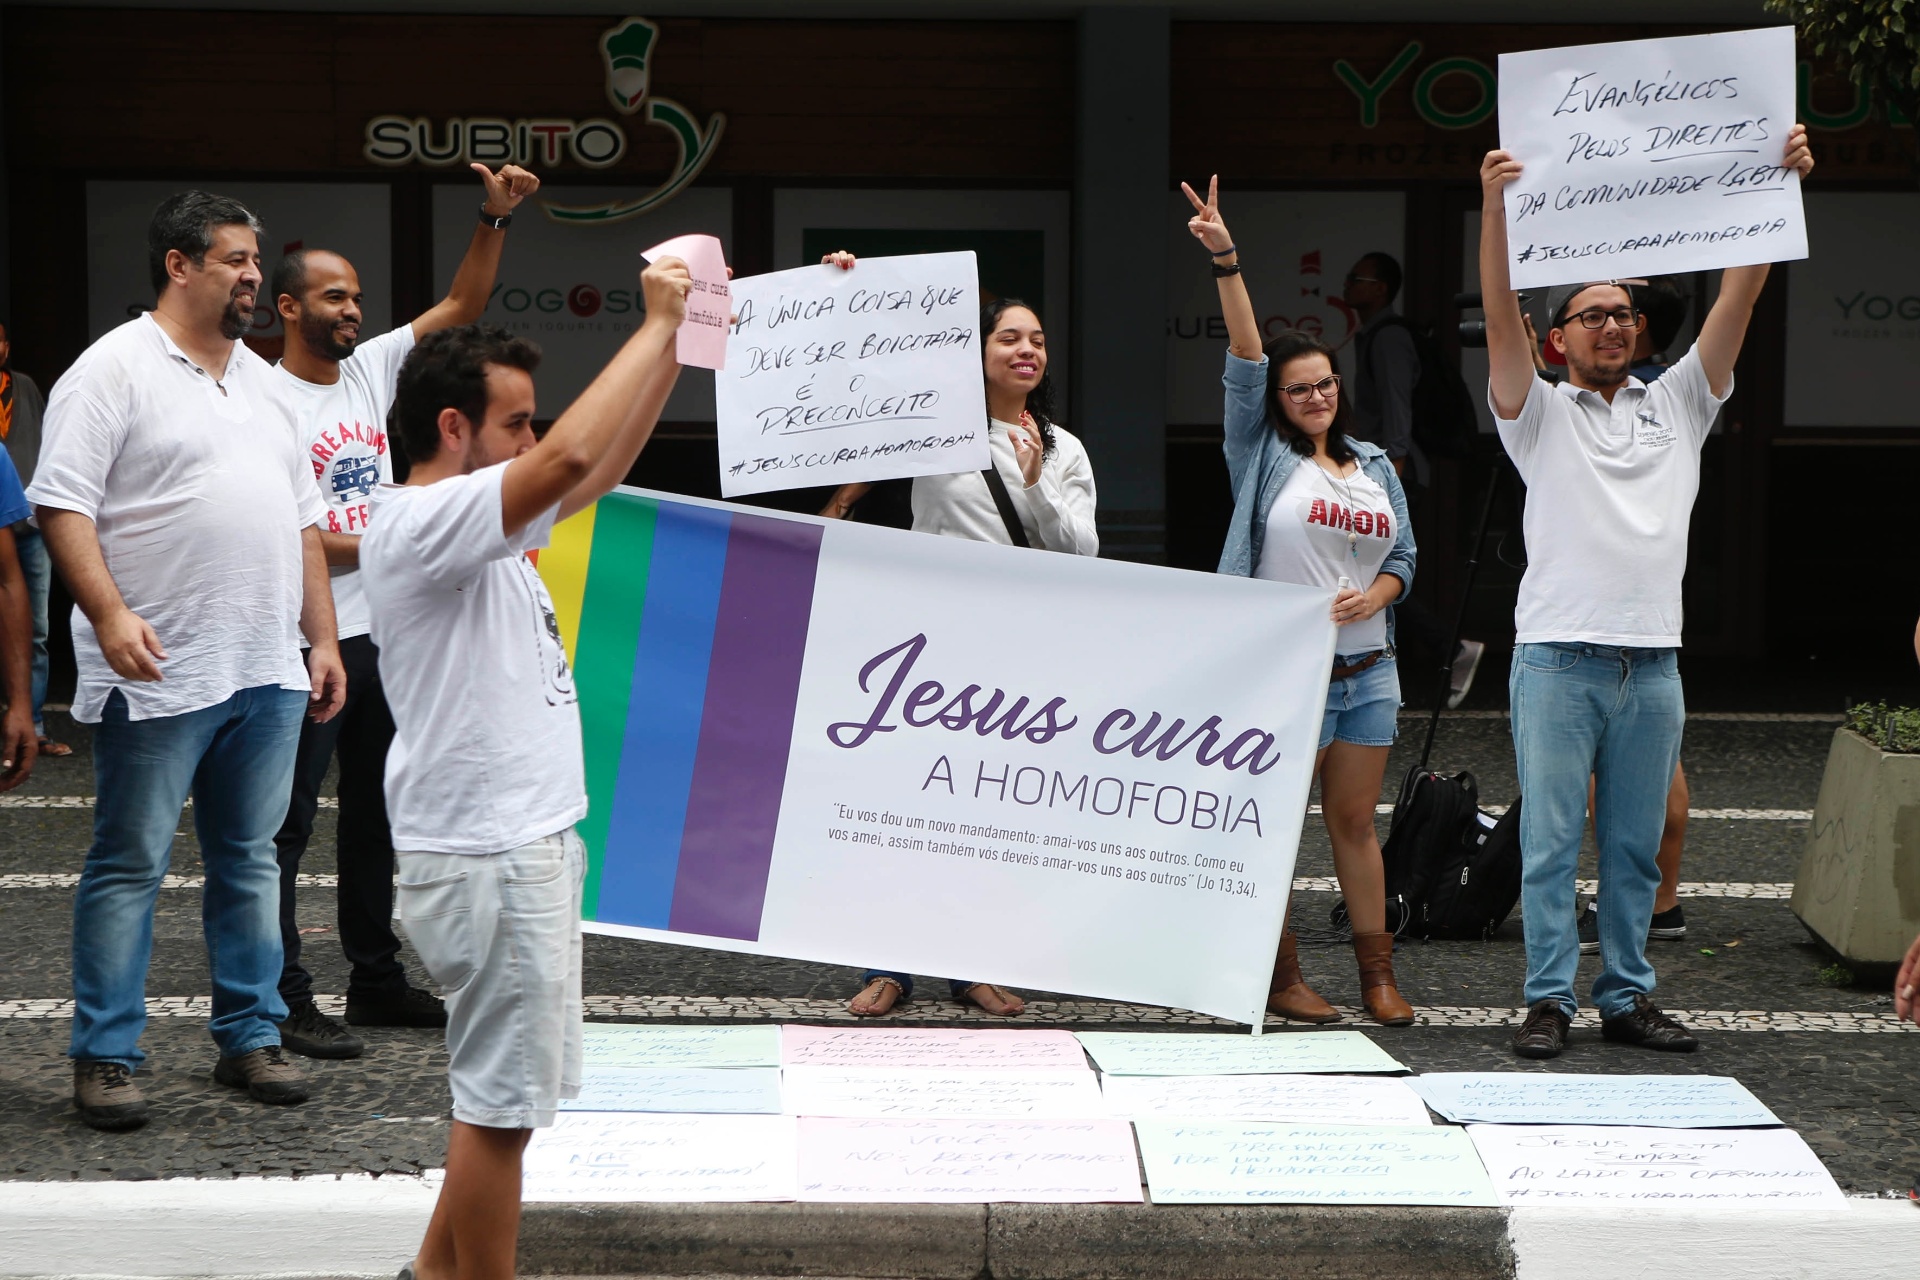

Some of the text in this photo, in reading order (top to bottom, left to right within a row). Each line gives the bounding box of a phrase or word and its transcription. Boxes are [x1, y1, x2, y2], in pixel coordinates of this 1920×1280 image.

[1553, 70, 1739, 117] EVANGÉLICOS
[367, 118, 625, 165] SUBITO
[1566, 117, 1769, 164] PELOS DIREITOS
[1516, 192, 1546, 223] DA
[1555, 174, 1715, 211] COMUNIDADE
[1517, 217, 1787, 264] #JESUSCURAAHOMOFOBIA
[711, 282, 729, 297] cura
[735, 286, 964, 336] A ÚNICA COISA QUE
[740, 327, 973, 379] DEVE SER BOICOTADA
[797, 373, 866, 401] É O
[756, 390, 940, 435] PRECONCEITO
[728, 430, 976, 477] #JESUSCURAAHOMOFOBIA
[1307, 499, 1390, 538] AMOR
[826, 632, 1281, 776] Jesus cura
[921, 754, 1263, 838] A HOMOFOBIA
[828, 828, 849, 841] vos
[851, 831, 884, 847] amei,
[888, 836, 924, 851] assim
[927, 839, 975, 858] também
[979, 845, 999, 861] vós
[1001, 848, 1039, 866] deveis
[1042, 857, 1097, 874] amar-vos
[1101, 865, 1122, 878] uns
[1125, 868, 1147, 882] aos
[1196, 873, 1215, 891] (Jo
[1219, 877, 1257, 899] 13,34).
[857, 810, 878, 823] vos
[881, 810, 903, 826] dou
[906, 817, 925, 829] um
[928, 820, 956, 833] novo
[959, 824, 1040, 844] mandamento:
[1043, 835, 1097, 852] amai-vos
[1100, 842, 1122, 856] uns
[1125, 846, 1146, 860] aos
[1149, 850, 1190, 866] outros.
[1194, 853, 1226, 870] Como
[1229, 861, 1244, 873] eu
[1515, 1134, 1629, 1148] JESUS
[1230, 1165, 1391, 1177] HOMOFOBIA
[1508, 1166, 1545, 1180] AO
[1556, 1169, 1630, 1179] LADO
[1640, 1169, 1679, 1179] DO
